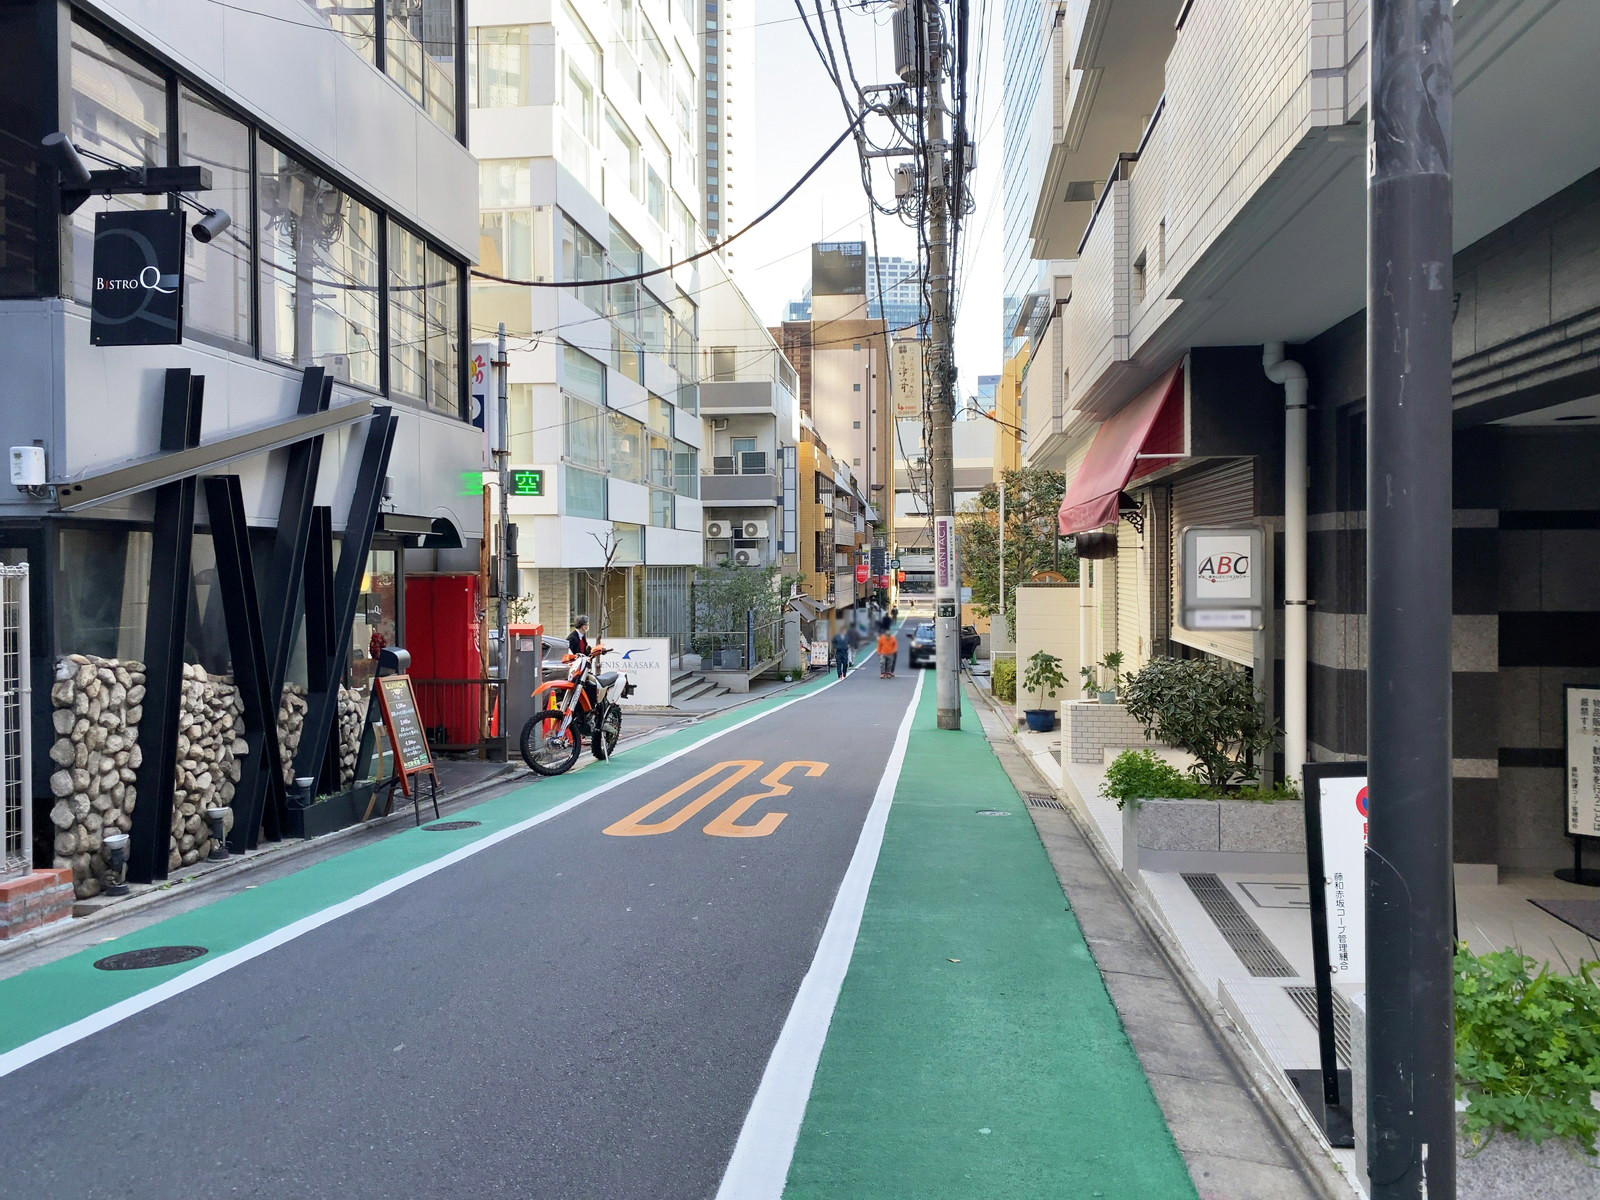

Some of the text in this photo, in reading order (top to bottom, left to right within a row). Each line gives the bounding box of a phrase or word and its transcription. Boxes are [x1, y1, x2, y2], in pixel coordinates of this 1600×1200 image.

[139, 265, 177, 294] Q
[515, 471, 540, 495] 空
[938, 523, 946, 586] GRANTACT
[1198, 555, 1249, 575] ABC
[597, 661, 660, 669] ENIS AKASAKA
[601, 759, 830, 838] 30
[1333, 872, 1349, 971] 藤和赤坂コープ管理組合
